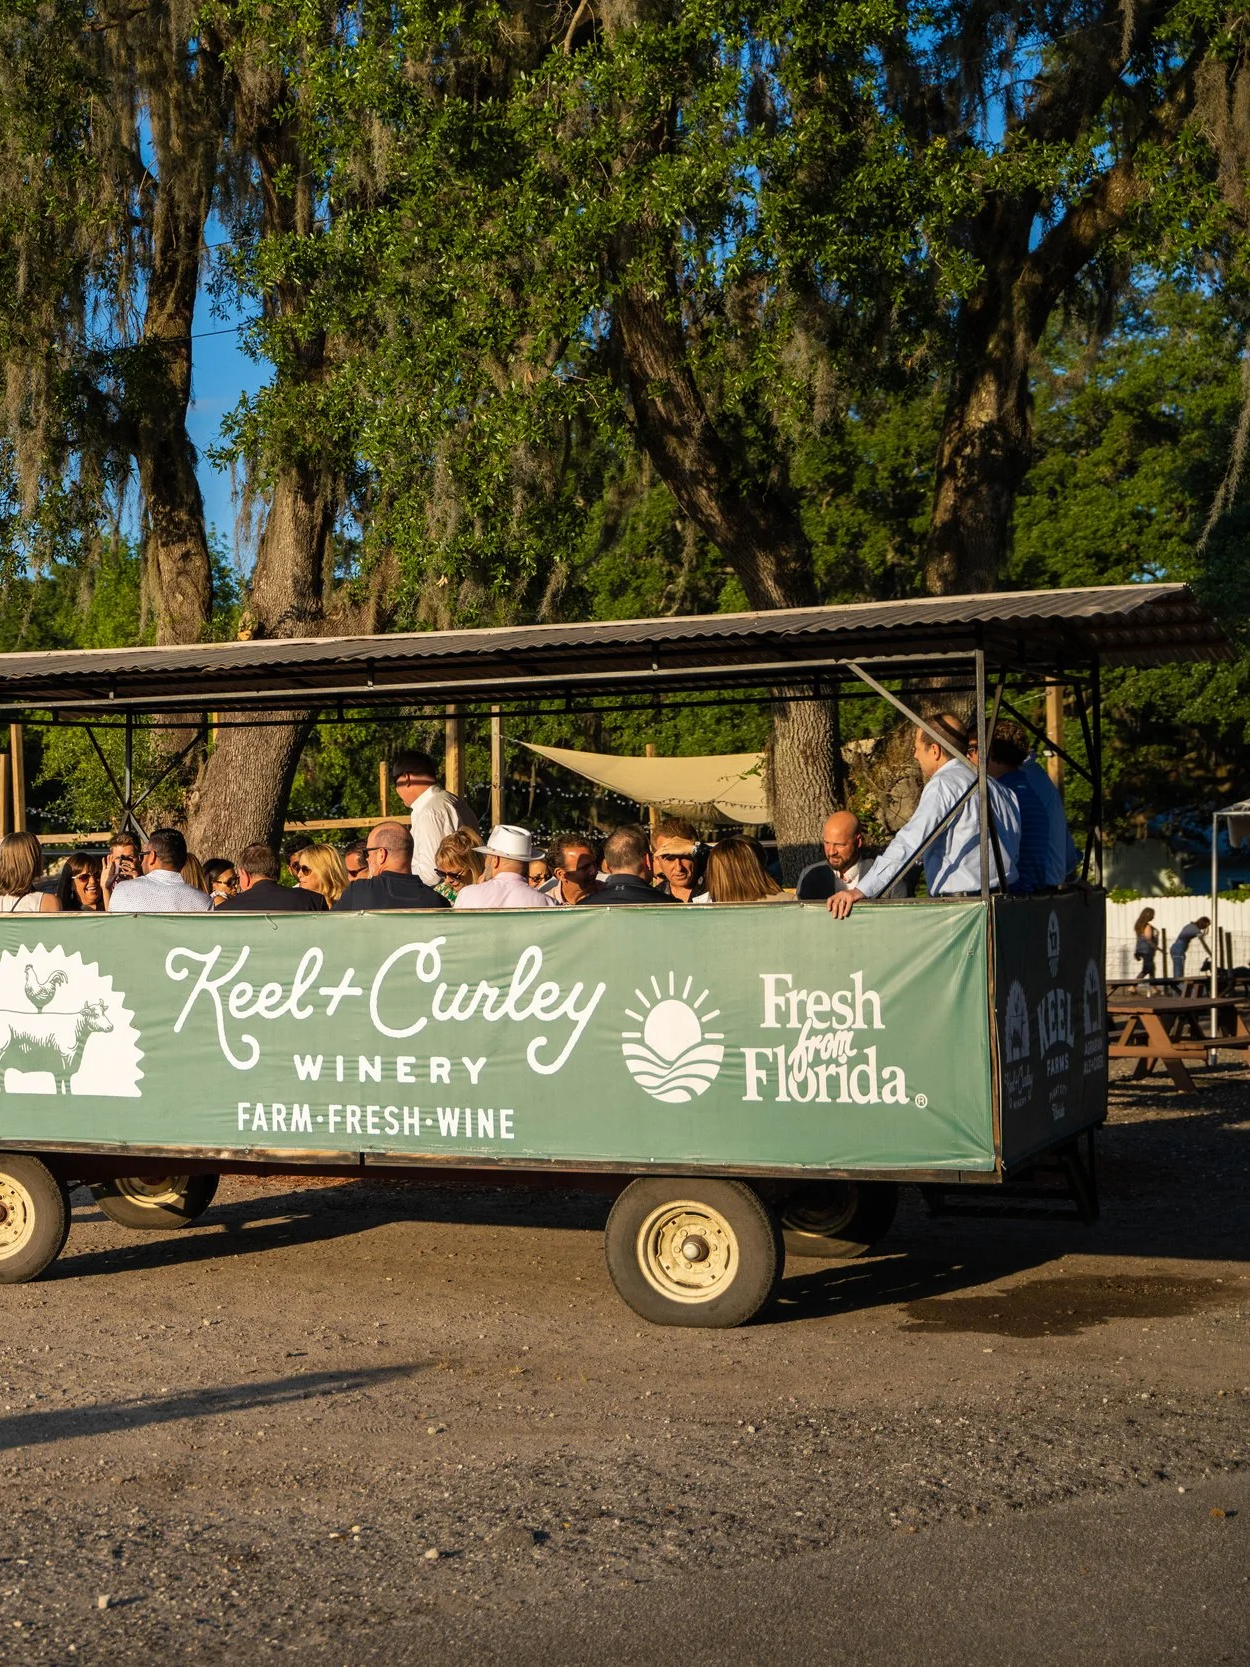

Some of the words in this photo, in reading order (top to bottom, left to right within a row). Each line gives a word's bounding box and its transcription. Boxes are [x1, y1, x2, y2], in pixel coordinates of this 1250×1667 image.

[165, 944, 324, 1070] Keel
[369, 936, 607, 1075] Curley
[758, 970, 886, 1029] Fresh
[1037, 987, 1075, 1061] KEEL
[293, 1054, 488, 1084] WINERY
[787, 1017, 858, 1083] from
[1046, 1051, 1070, 1078] FARMS
